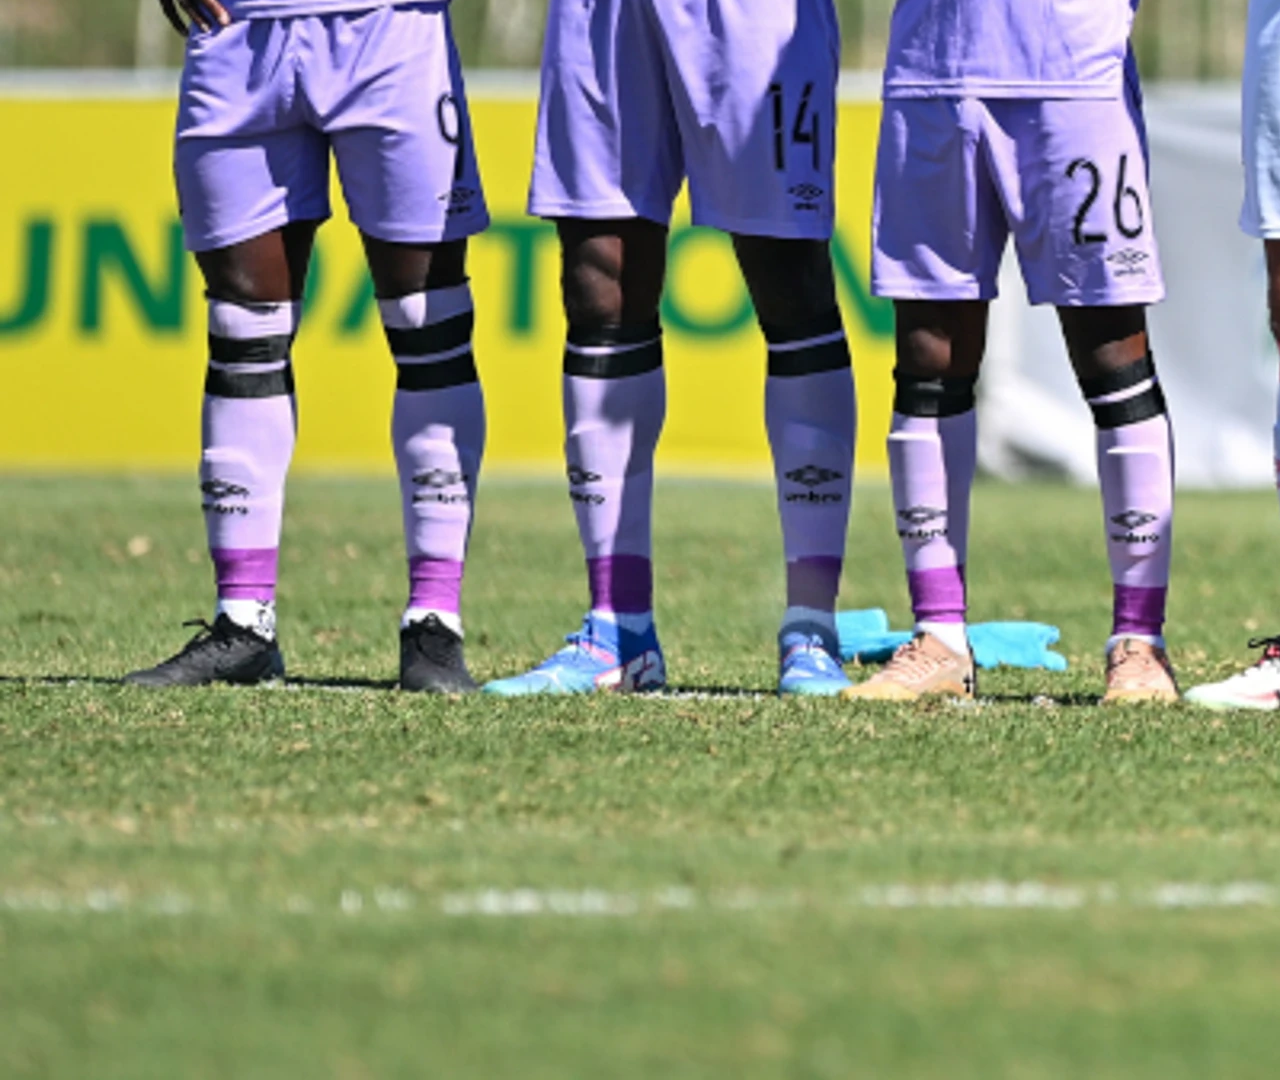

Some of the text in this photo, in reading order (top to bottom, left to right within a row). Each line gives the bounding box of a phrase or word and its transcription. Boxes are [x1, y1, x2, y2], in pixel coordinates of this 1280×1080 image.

[436, 92, 464, 183] 9
[769, 81, 821, 172] 14
[1065, 153, 1144, 245] 26
